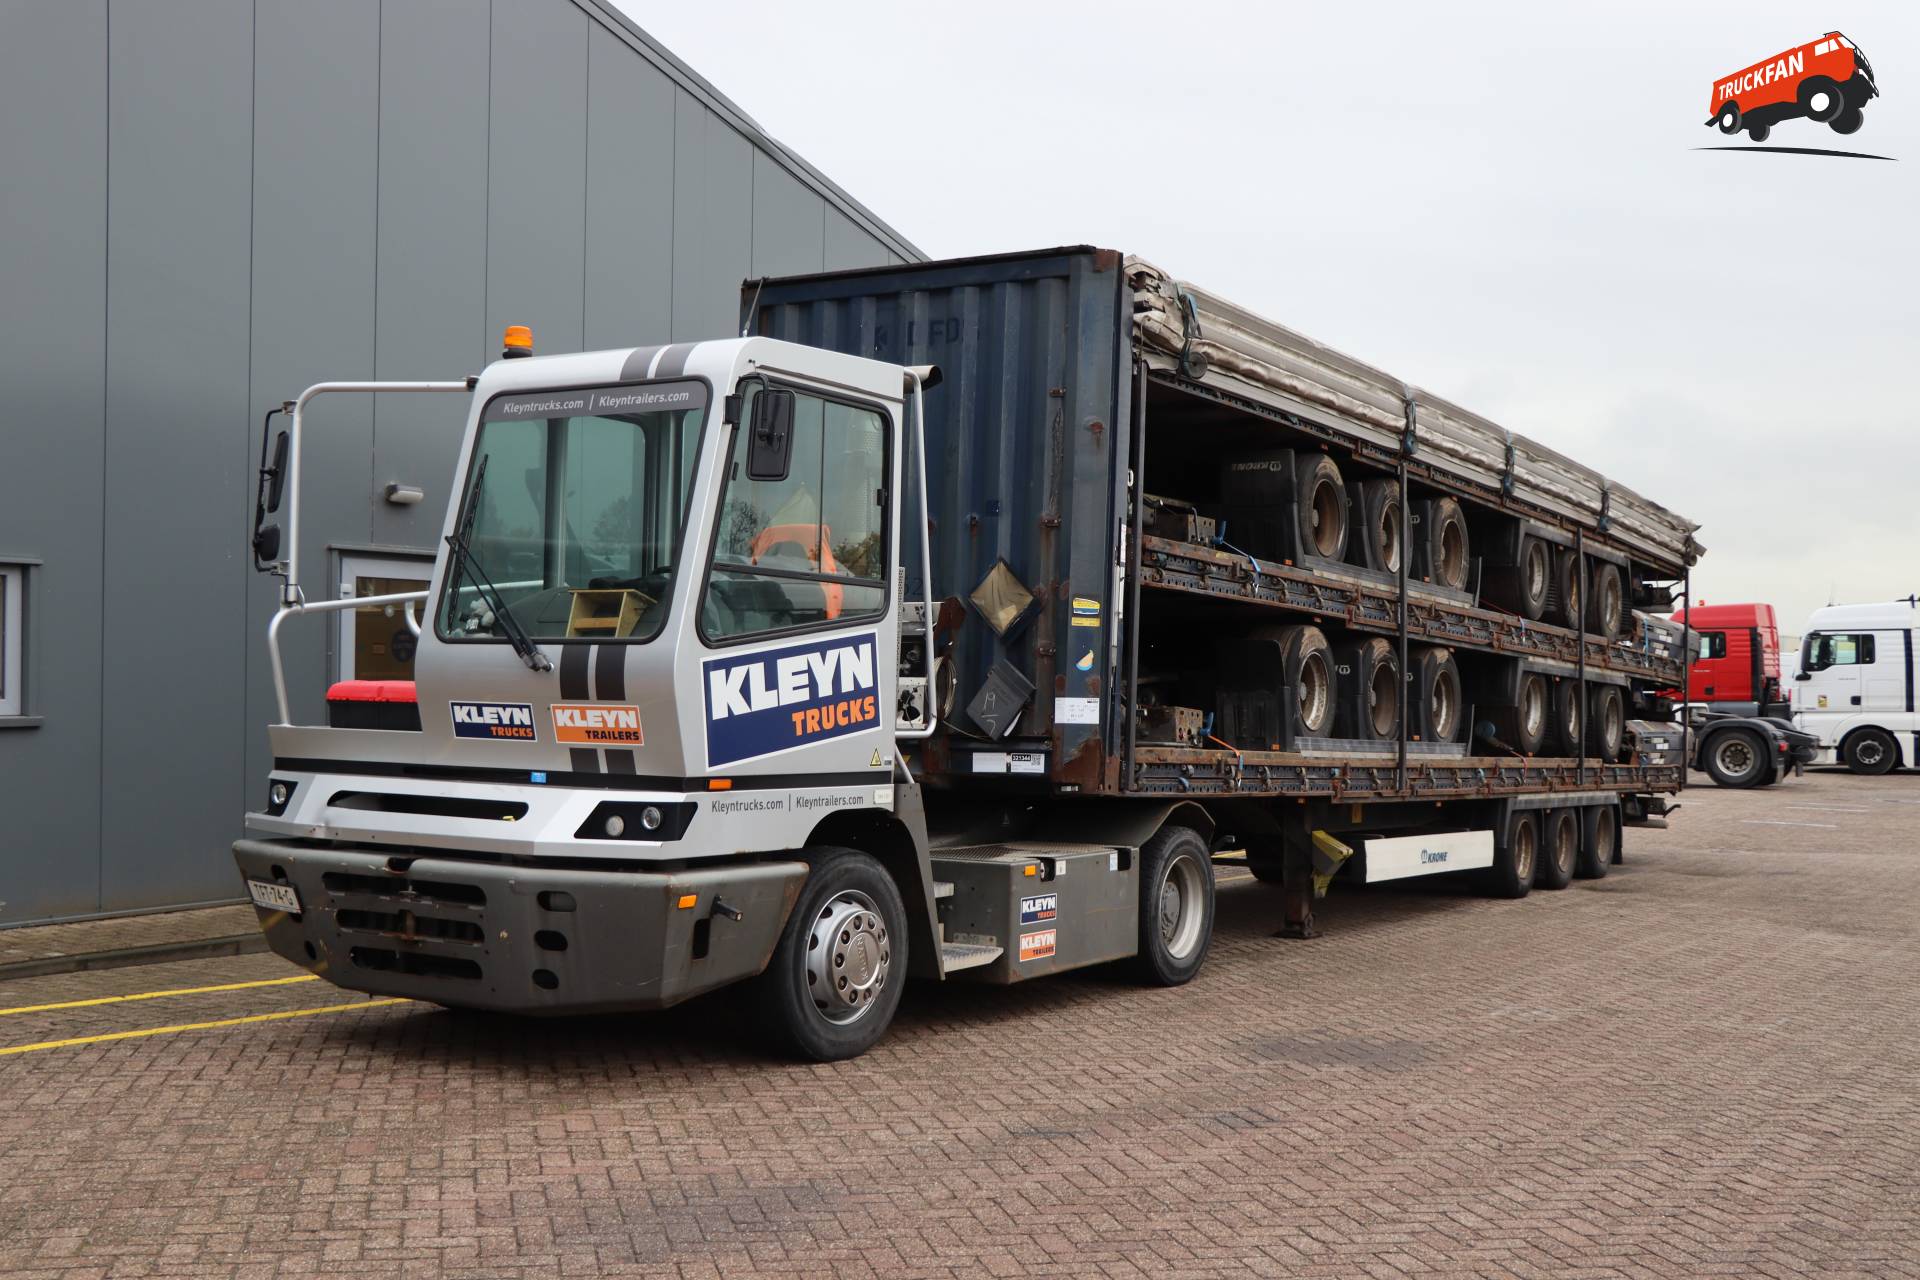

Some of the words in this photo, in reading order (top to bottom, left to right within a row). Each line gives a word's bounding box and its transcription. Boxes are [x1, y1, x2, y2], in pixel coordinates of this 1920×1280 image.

[503, 399, 584, 415] Kleyntrucks.com
[599, 392, 690, 408] Kleyntrailers.com
[709, 642, 874, 721] KLEYN
[453, 705, 532, 726] KLEYN
[555, 709, 638, 729] KLEYN
[791, 695, 876, 737] TRUCKS
[490, 726, 533, 737] TRUCKS
[585, 730, 640, 741] TRAILERS
[711, 799, 784, 814] Kleyntrucks.com
[796, 795, 864, 808] Kleyntrailers.com
[1022, 897, 1056, 913] KLEYN
[1021, 933, 1055, 949] KLEYN
